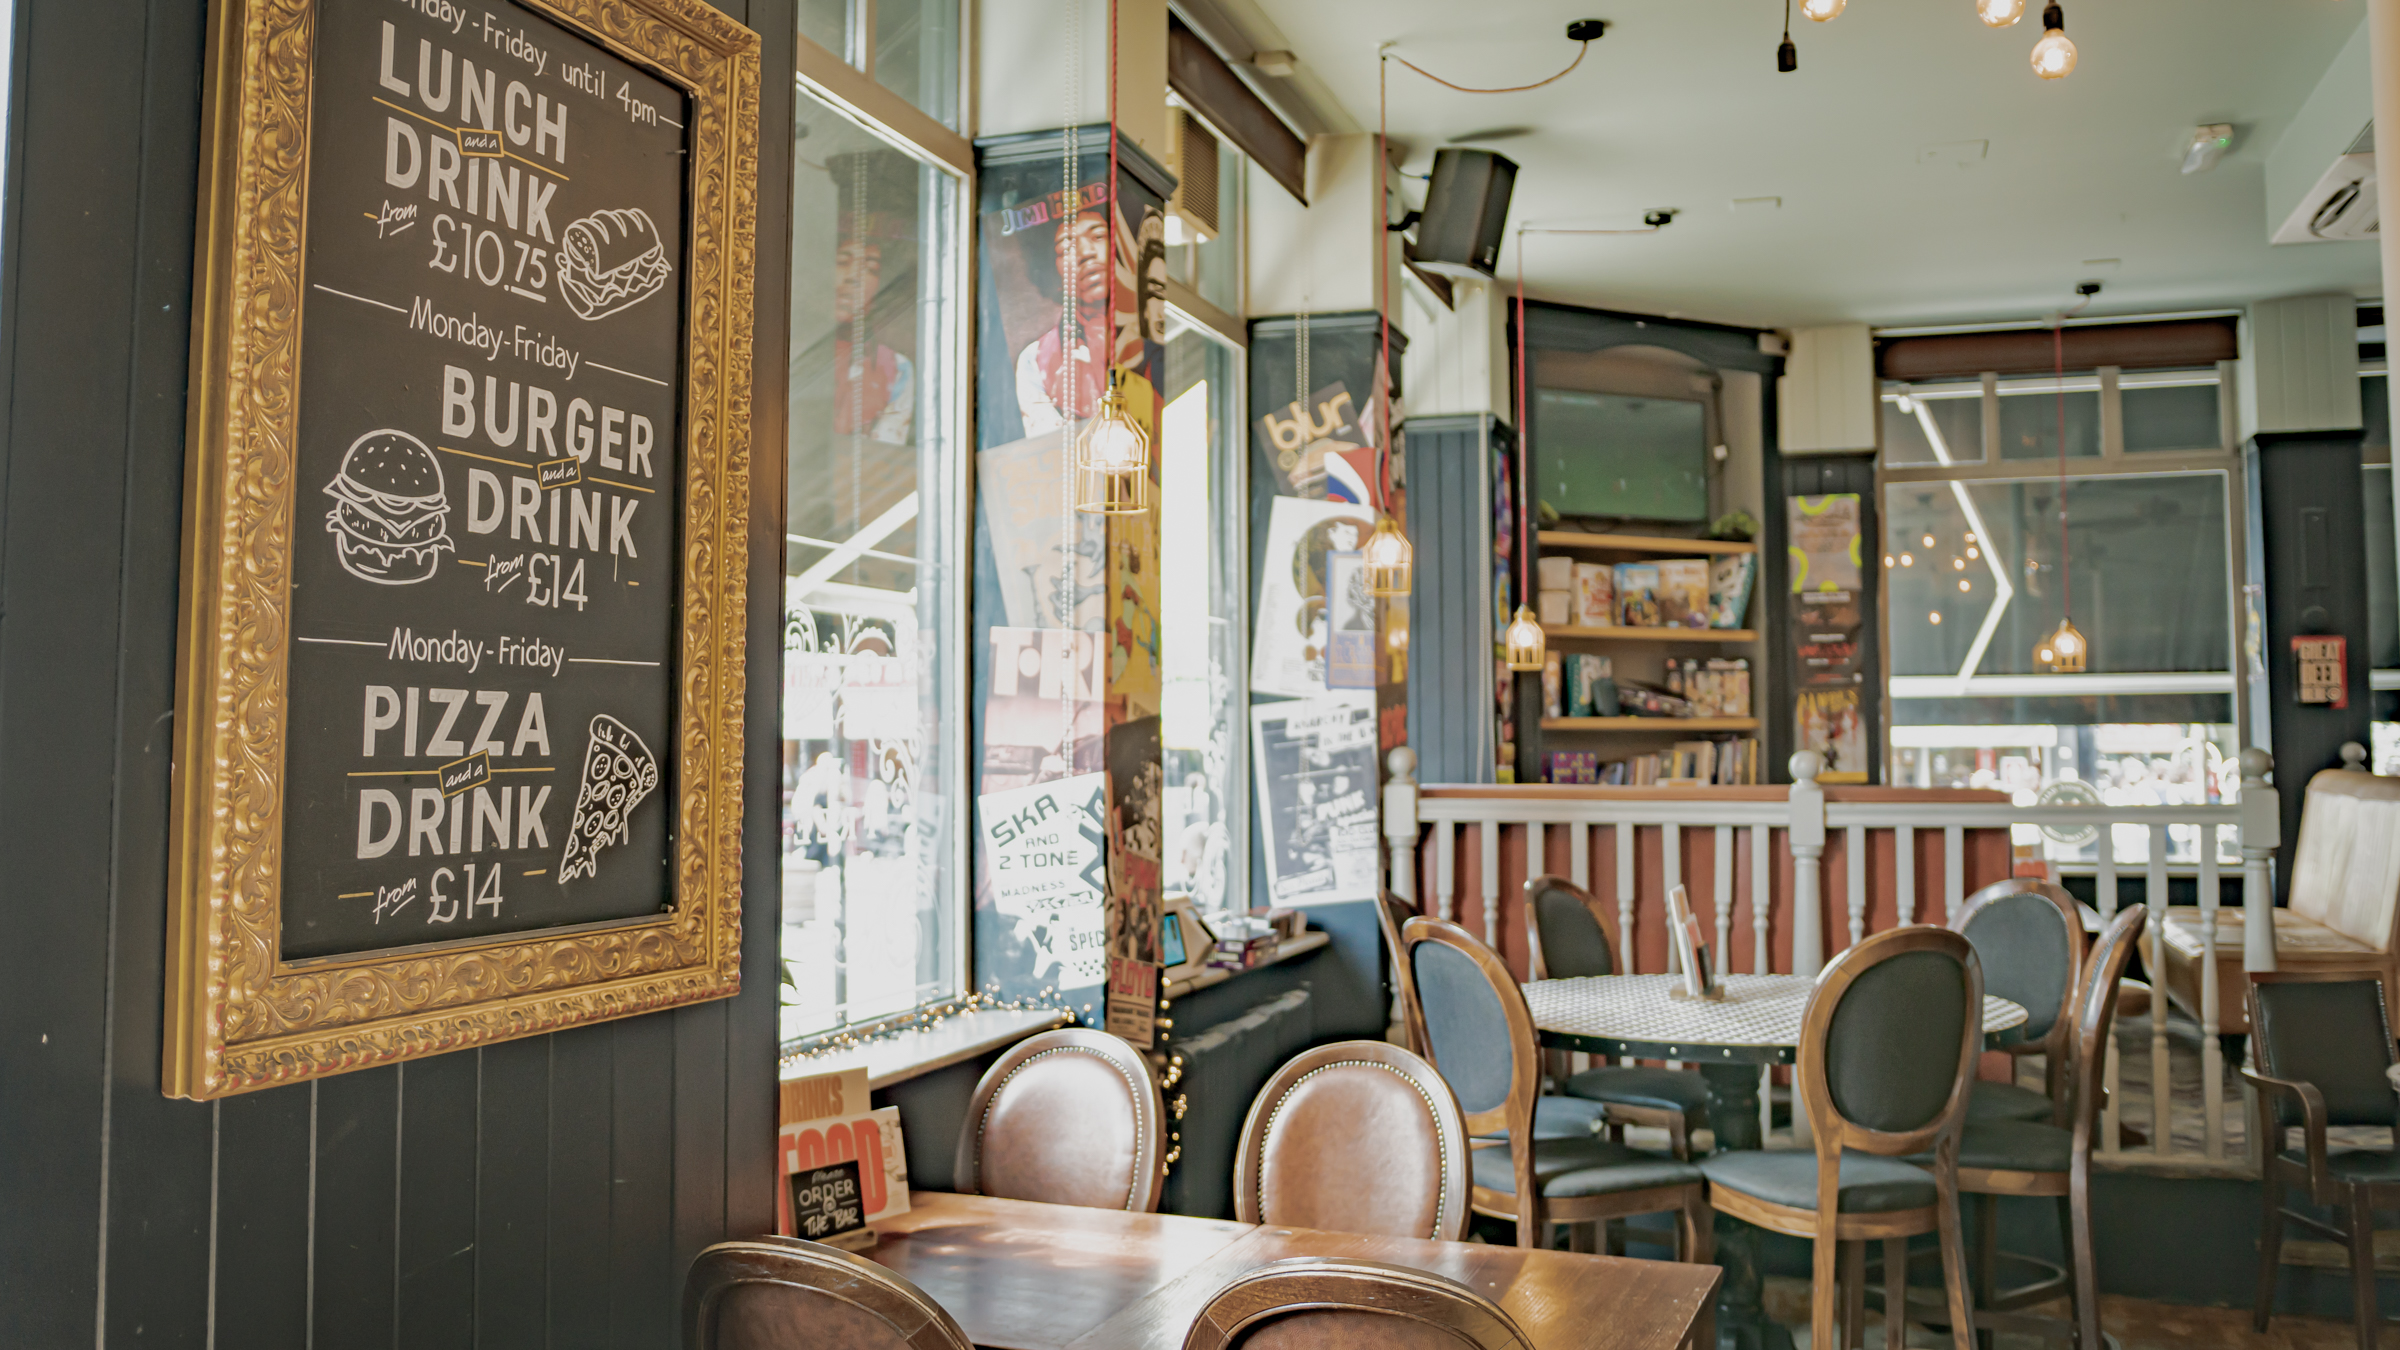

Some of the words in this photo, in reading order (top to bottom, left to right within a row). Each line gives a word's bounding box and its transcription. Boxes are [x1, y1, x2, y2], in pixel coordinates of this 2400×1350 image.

[380, 20, 567, 164] LUNCH
[562, 62, 605, 100] until
[616, 81, 657, 127] 4pm
[386, 116, 557, 244] DRINK
[377, 200, 418, 239] from
[1001, 202, 1050, 237] JIMI
[410, 296, 579, 381] Monday-Friday
[442, 364, 654, 478] BURGER
[1264, 391, 1351, 451] blur
[467, 468, 639, 558] DRINK
[484, 554, 523, 592] from
[526, 552, 589, 612] £14
[388, 627, 564, 677] Monday-Friday
[363, 685, 550, 757] PIZZA
[357, 785, 552, 859] DRINK
[990, 793, 1061, 848] SKA
[1026, 833, 1060, 848] AND
[1001, 879, 1066, 898] MADNESS
[1019, 850, 1079, 869] TONE
[373, 878, 417, 925] from
[427, 863, 504, 925] £14
[799, 1178, 854, 1207] ORDER
[803, 1212, 830, 1237] THE
[834, 1206, 860, 1229] BAR
